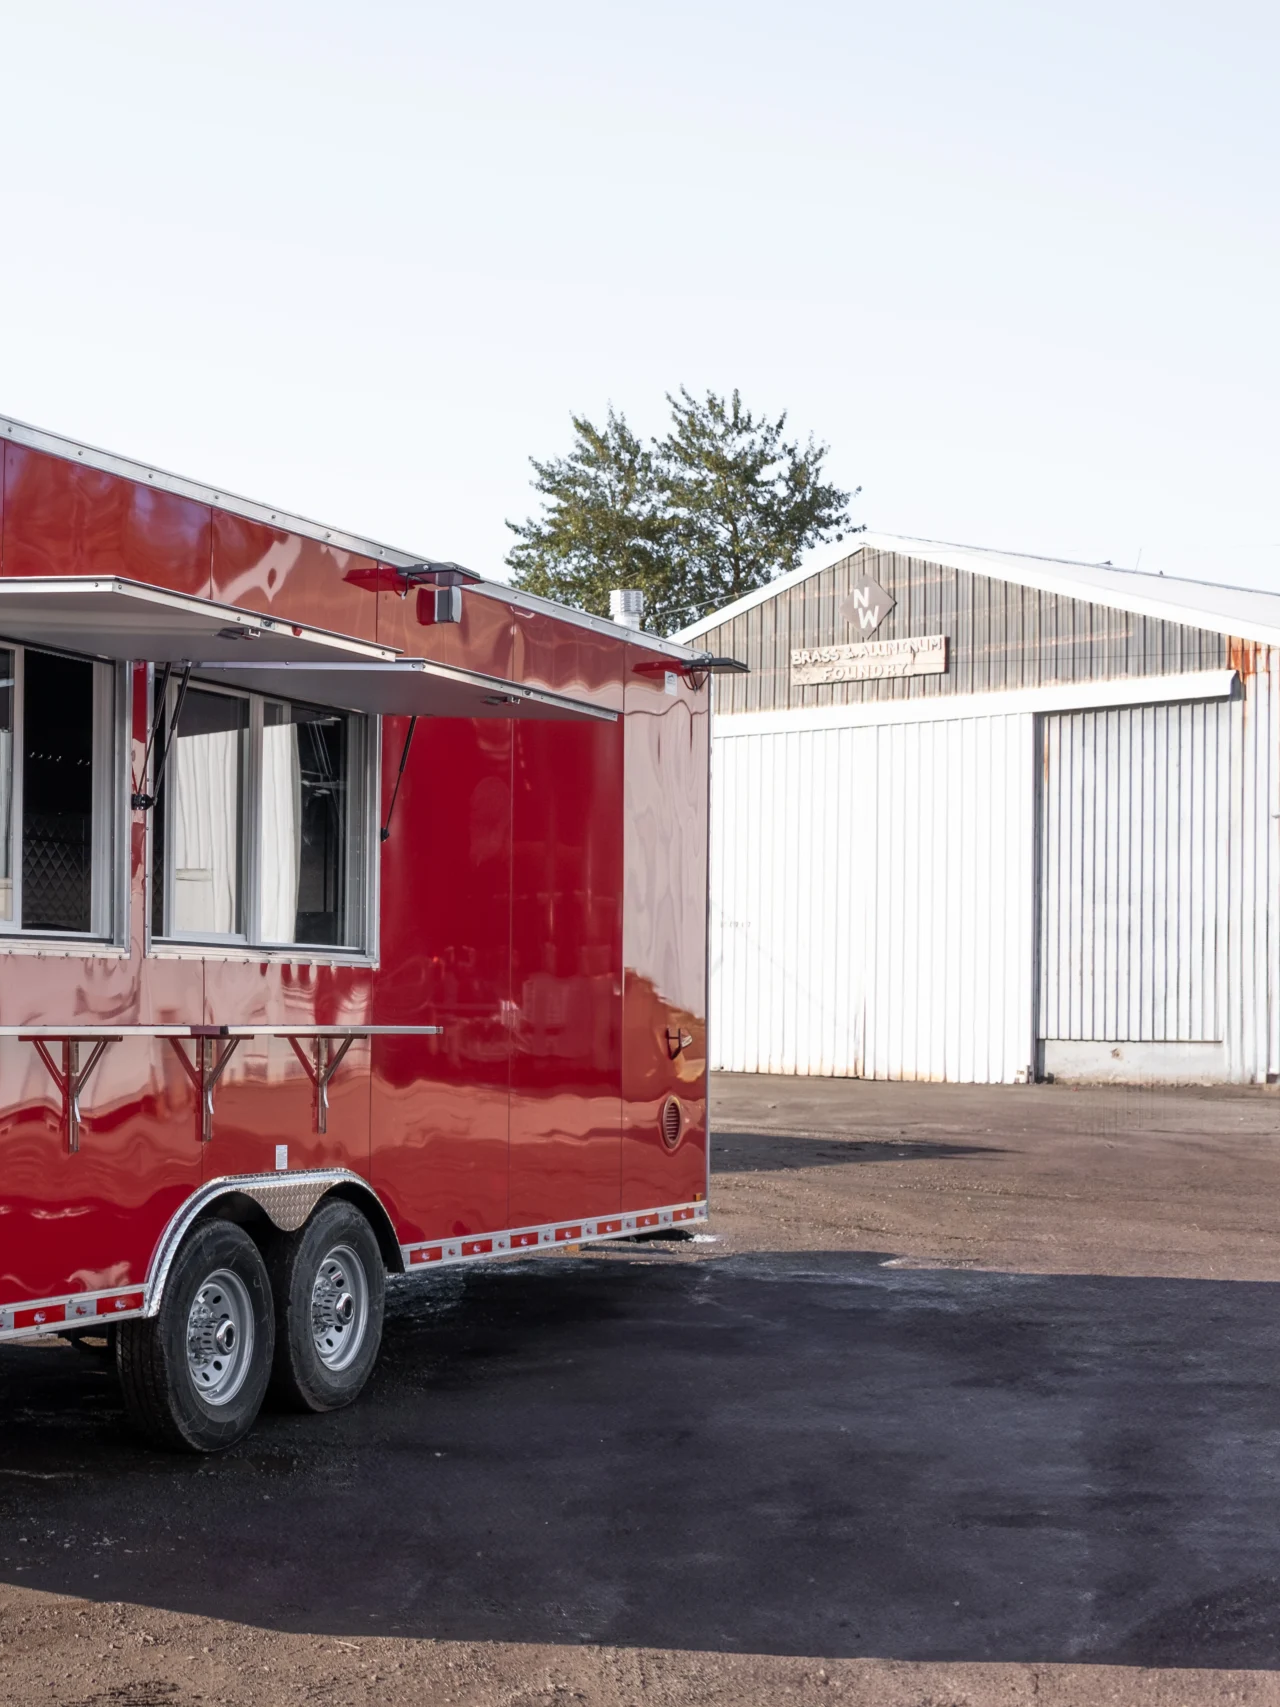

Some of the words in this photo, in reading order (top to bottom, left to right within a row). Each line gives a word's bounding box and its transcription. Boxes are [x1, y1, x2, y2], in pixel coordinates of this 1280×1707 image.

[791, 649, 840, 665] BRASS
[843, 645, 856, 659] &
[856, 637, 942, 658] ALUMINUM
[823, 664, 907, 682] FOUNDRY
